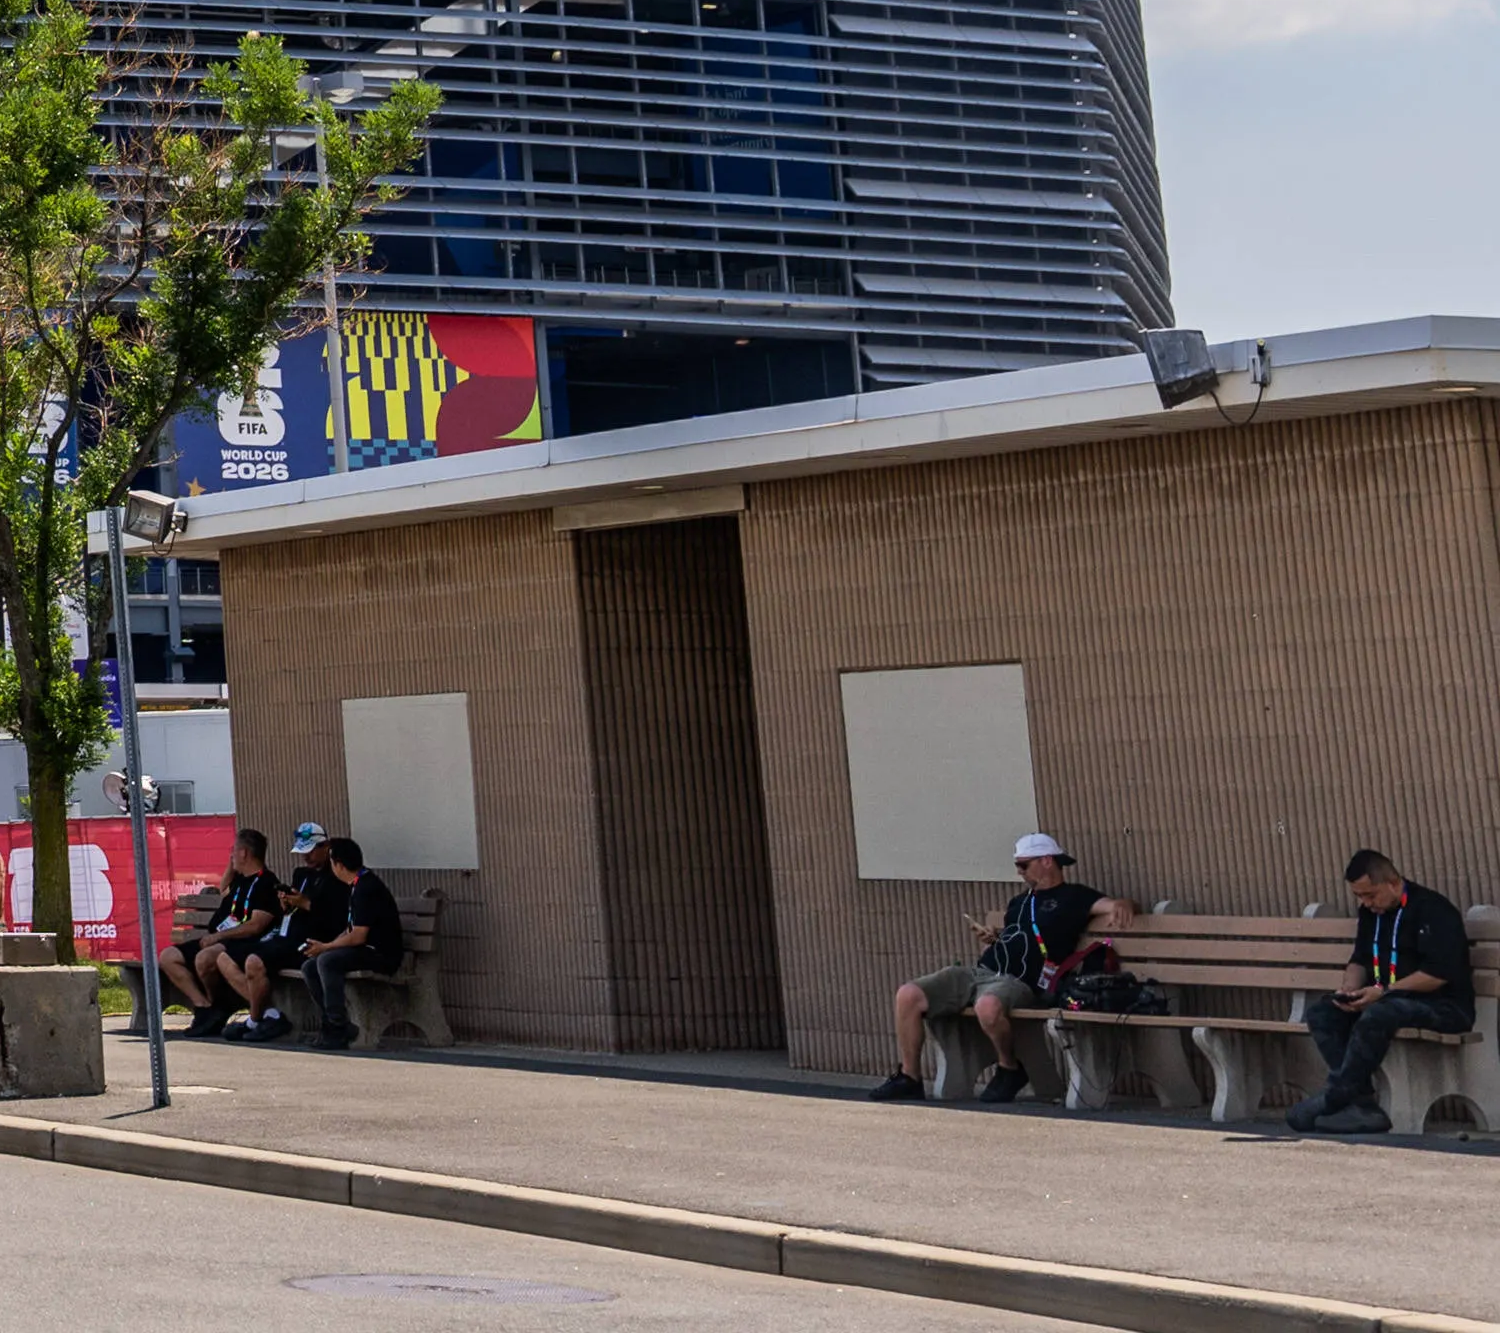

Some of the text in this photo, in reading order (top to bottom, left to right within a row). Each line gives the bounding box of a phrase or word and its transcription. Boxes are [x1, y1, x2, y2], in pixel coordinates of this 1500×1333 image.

[238, 423, 268, 435] FIFA
[221, 449, 288, 461] WORLD CUP
[221, 462, 289, 481] 2026
[84, 924, 117, 939] 2026
